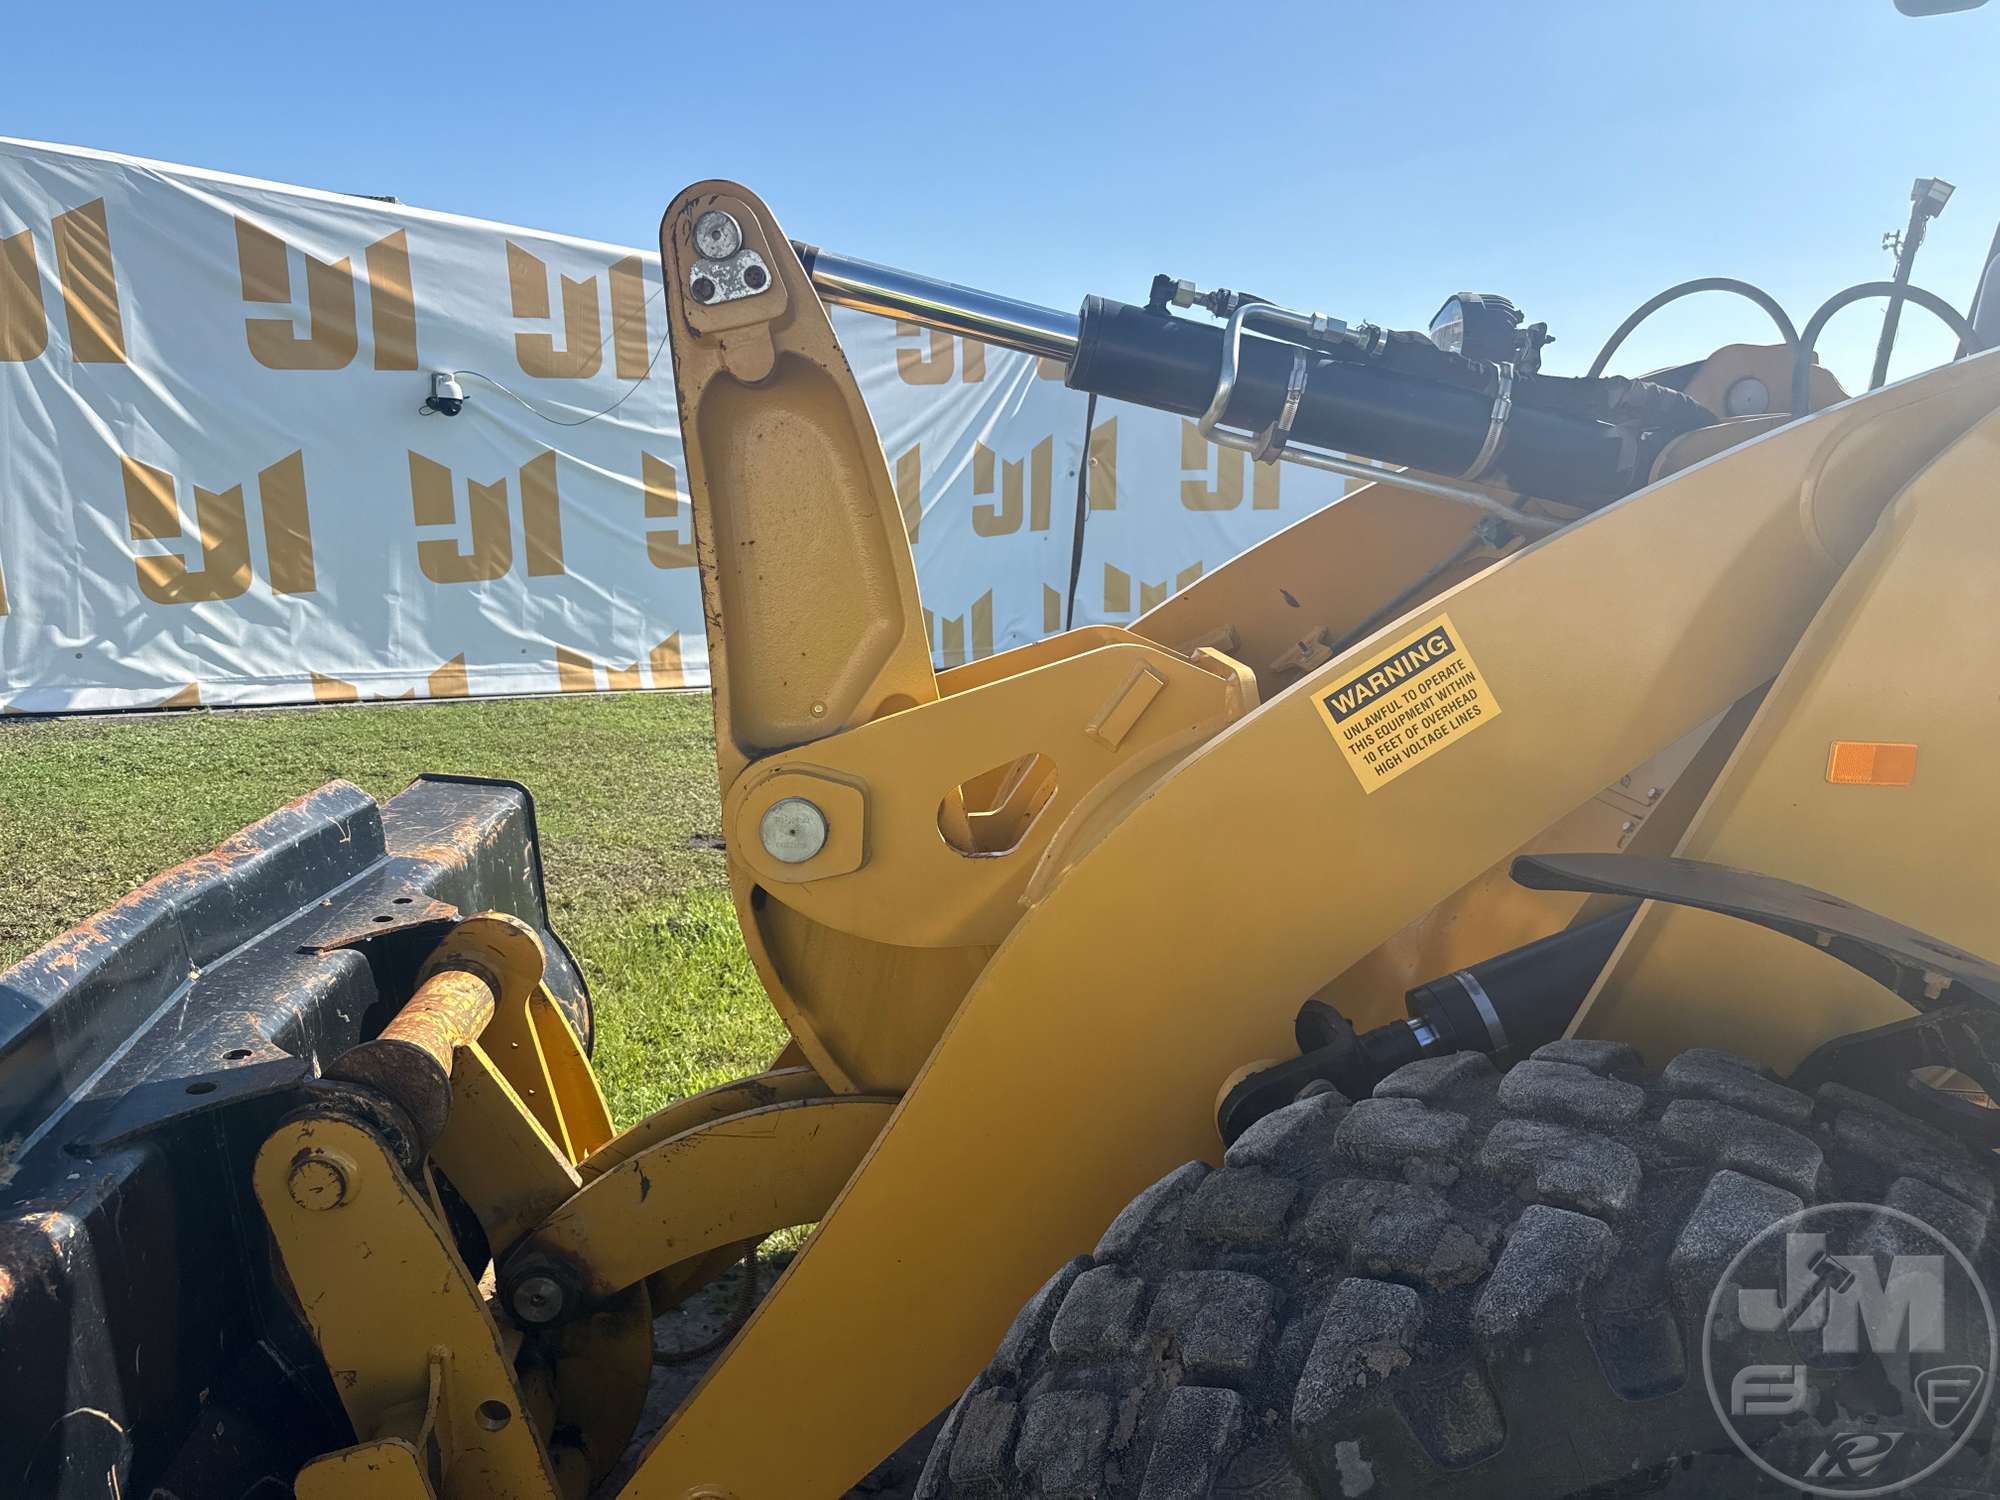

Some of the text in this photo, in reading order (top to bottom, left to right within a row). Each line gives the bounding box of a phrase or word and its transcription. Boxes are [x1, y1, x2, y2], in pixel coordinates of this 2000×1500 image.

[1330, 635, 1448, 714] WARNING
[1343, 659, 1466, 741] UNLAWFUL TO OPERATE
[1348, 671, 1476, 755] THIS EQUIPMENT WITHIN
[1363, 688, 1478, 764] 10 FEET OF OVERHEAD
[1374, 705, 1482, 776] HIGH VOLTAGE LINES
